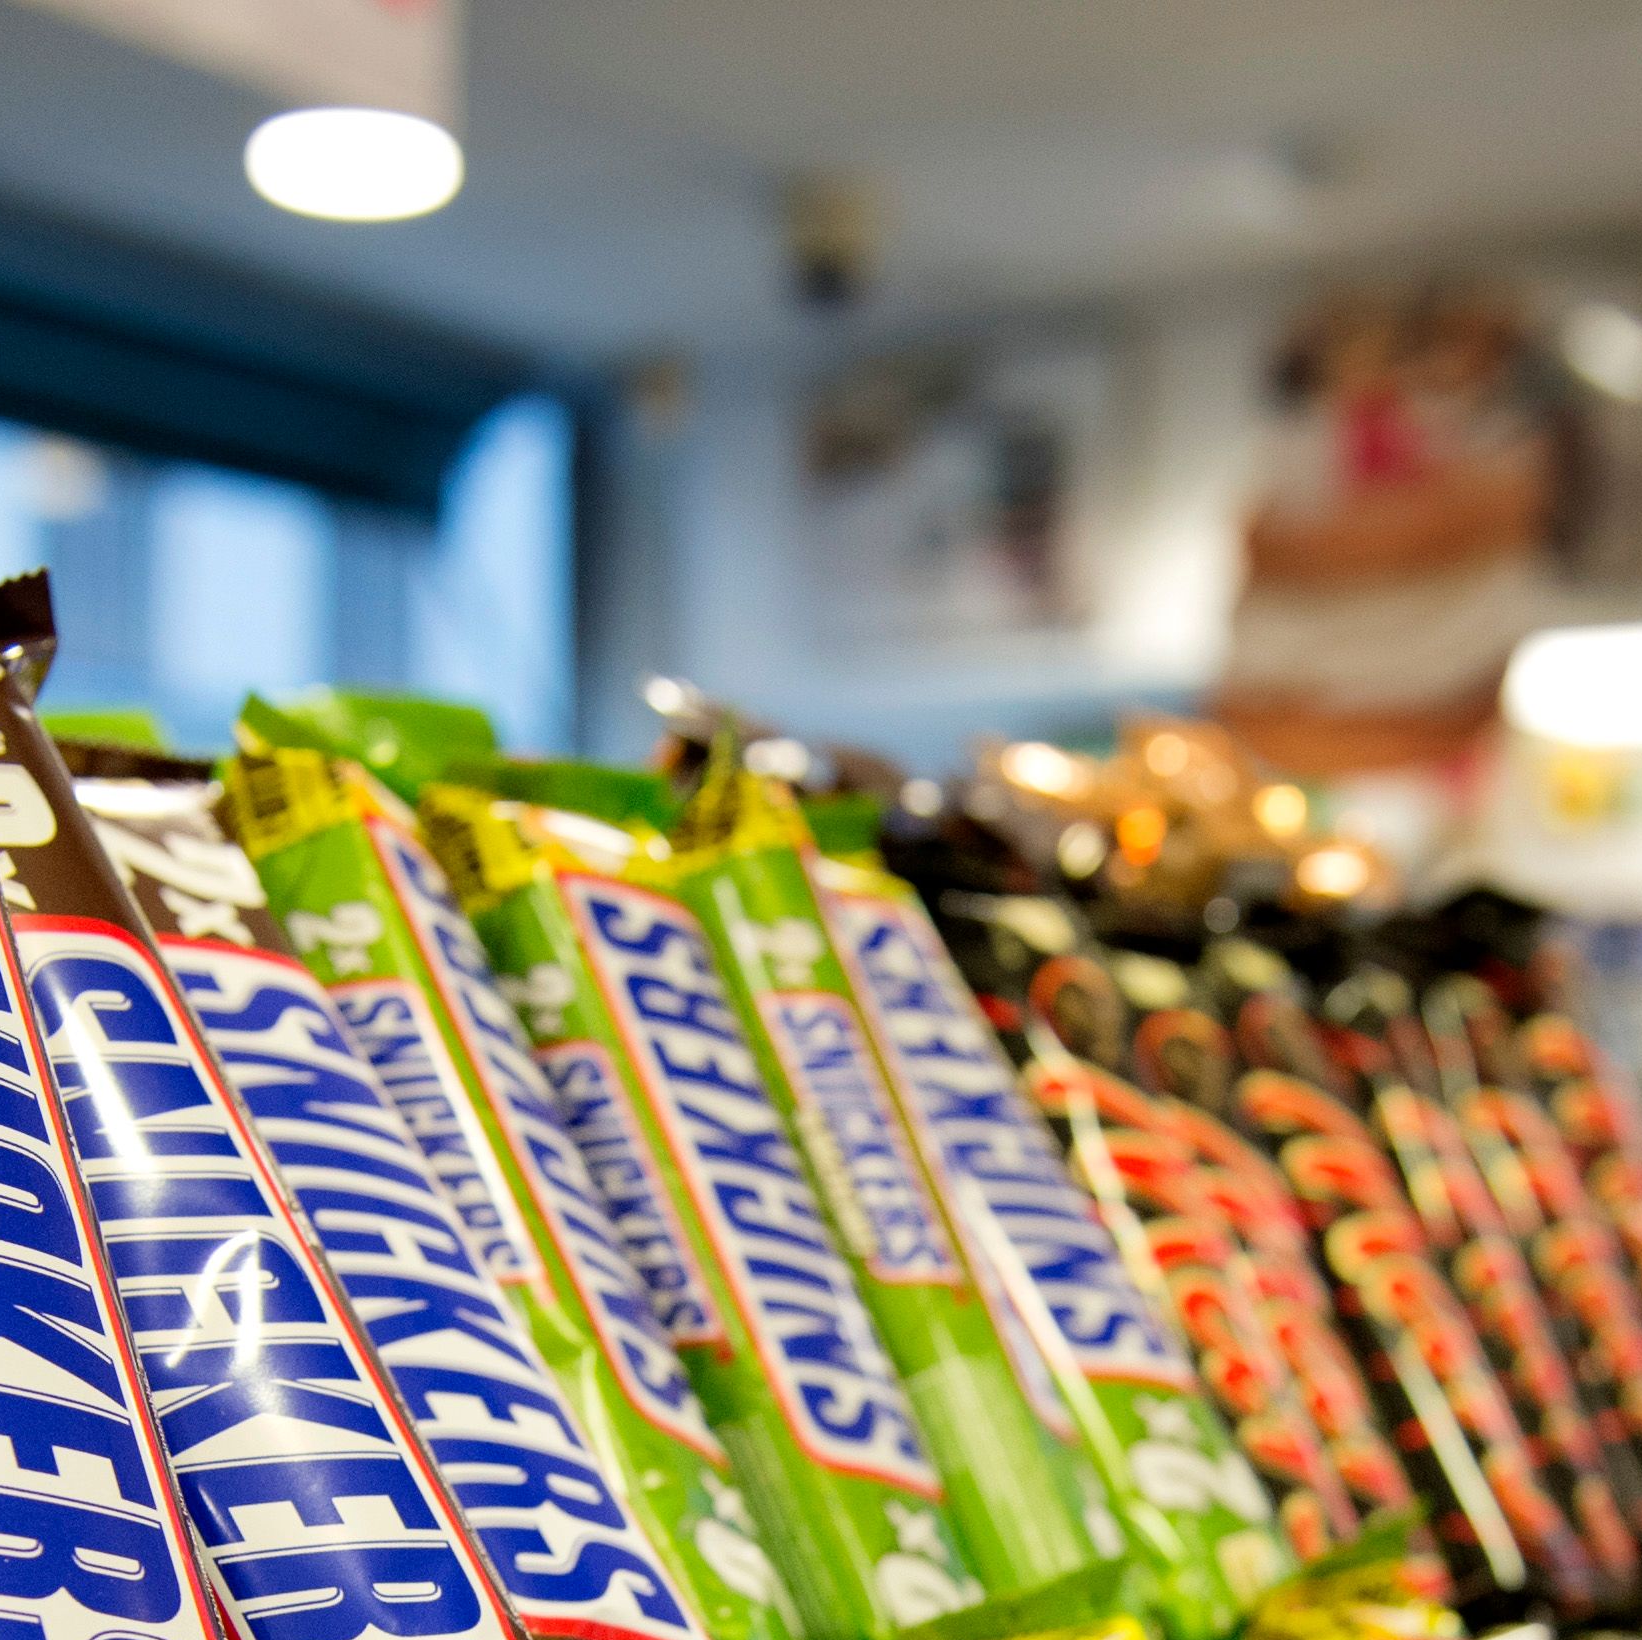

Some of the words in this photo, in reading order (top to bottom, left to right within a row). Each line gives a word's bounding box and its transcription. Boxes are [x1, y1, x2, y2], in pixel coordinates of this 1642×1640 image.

[172, 965, 693, 1632] SNICKERS
[336, 996, 531, 1277] SNICKERS
[545, 1052, 714, 1345] SNICKERS
[585, 896, 924, 1472] SNICKERS
